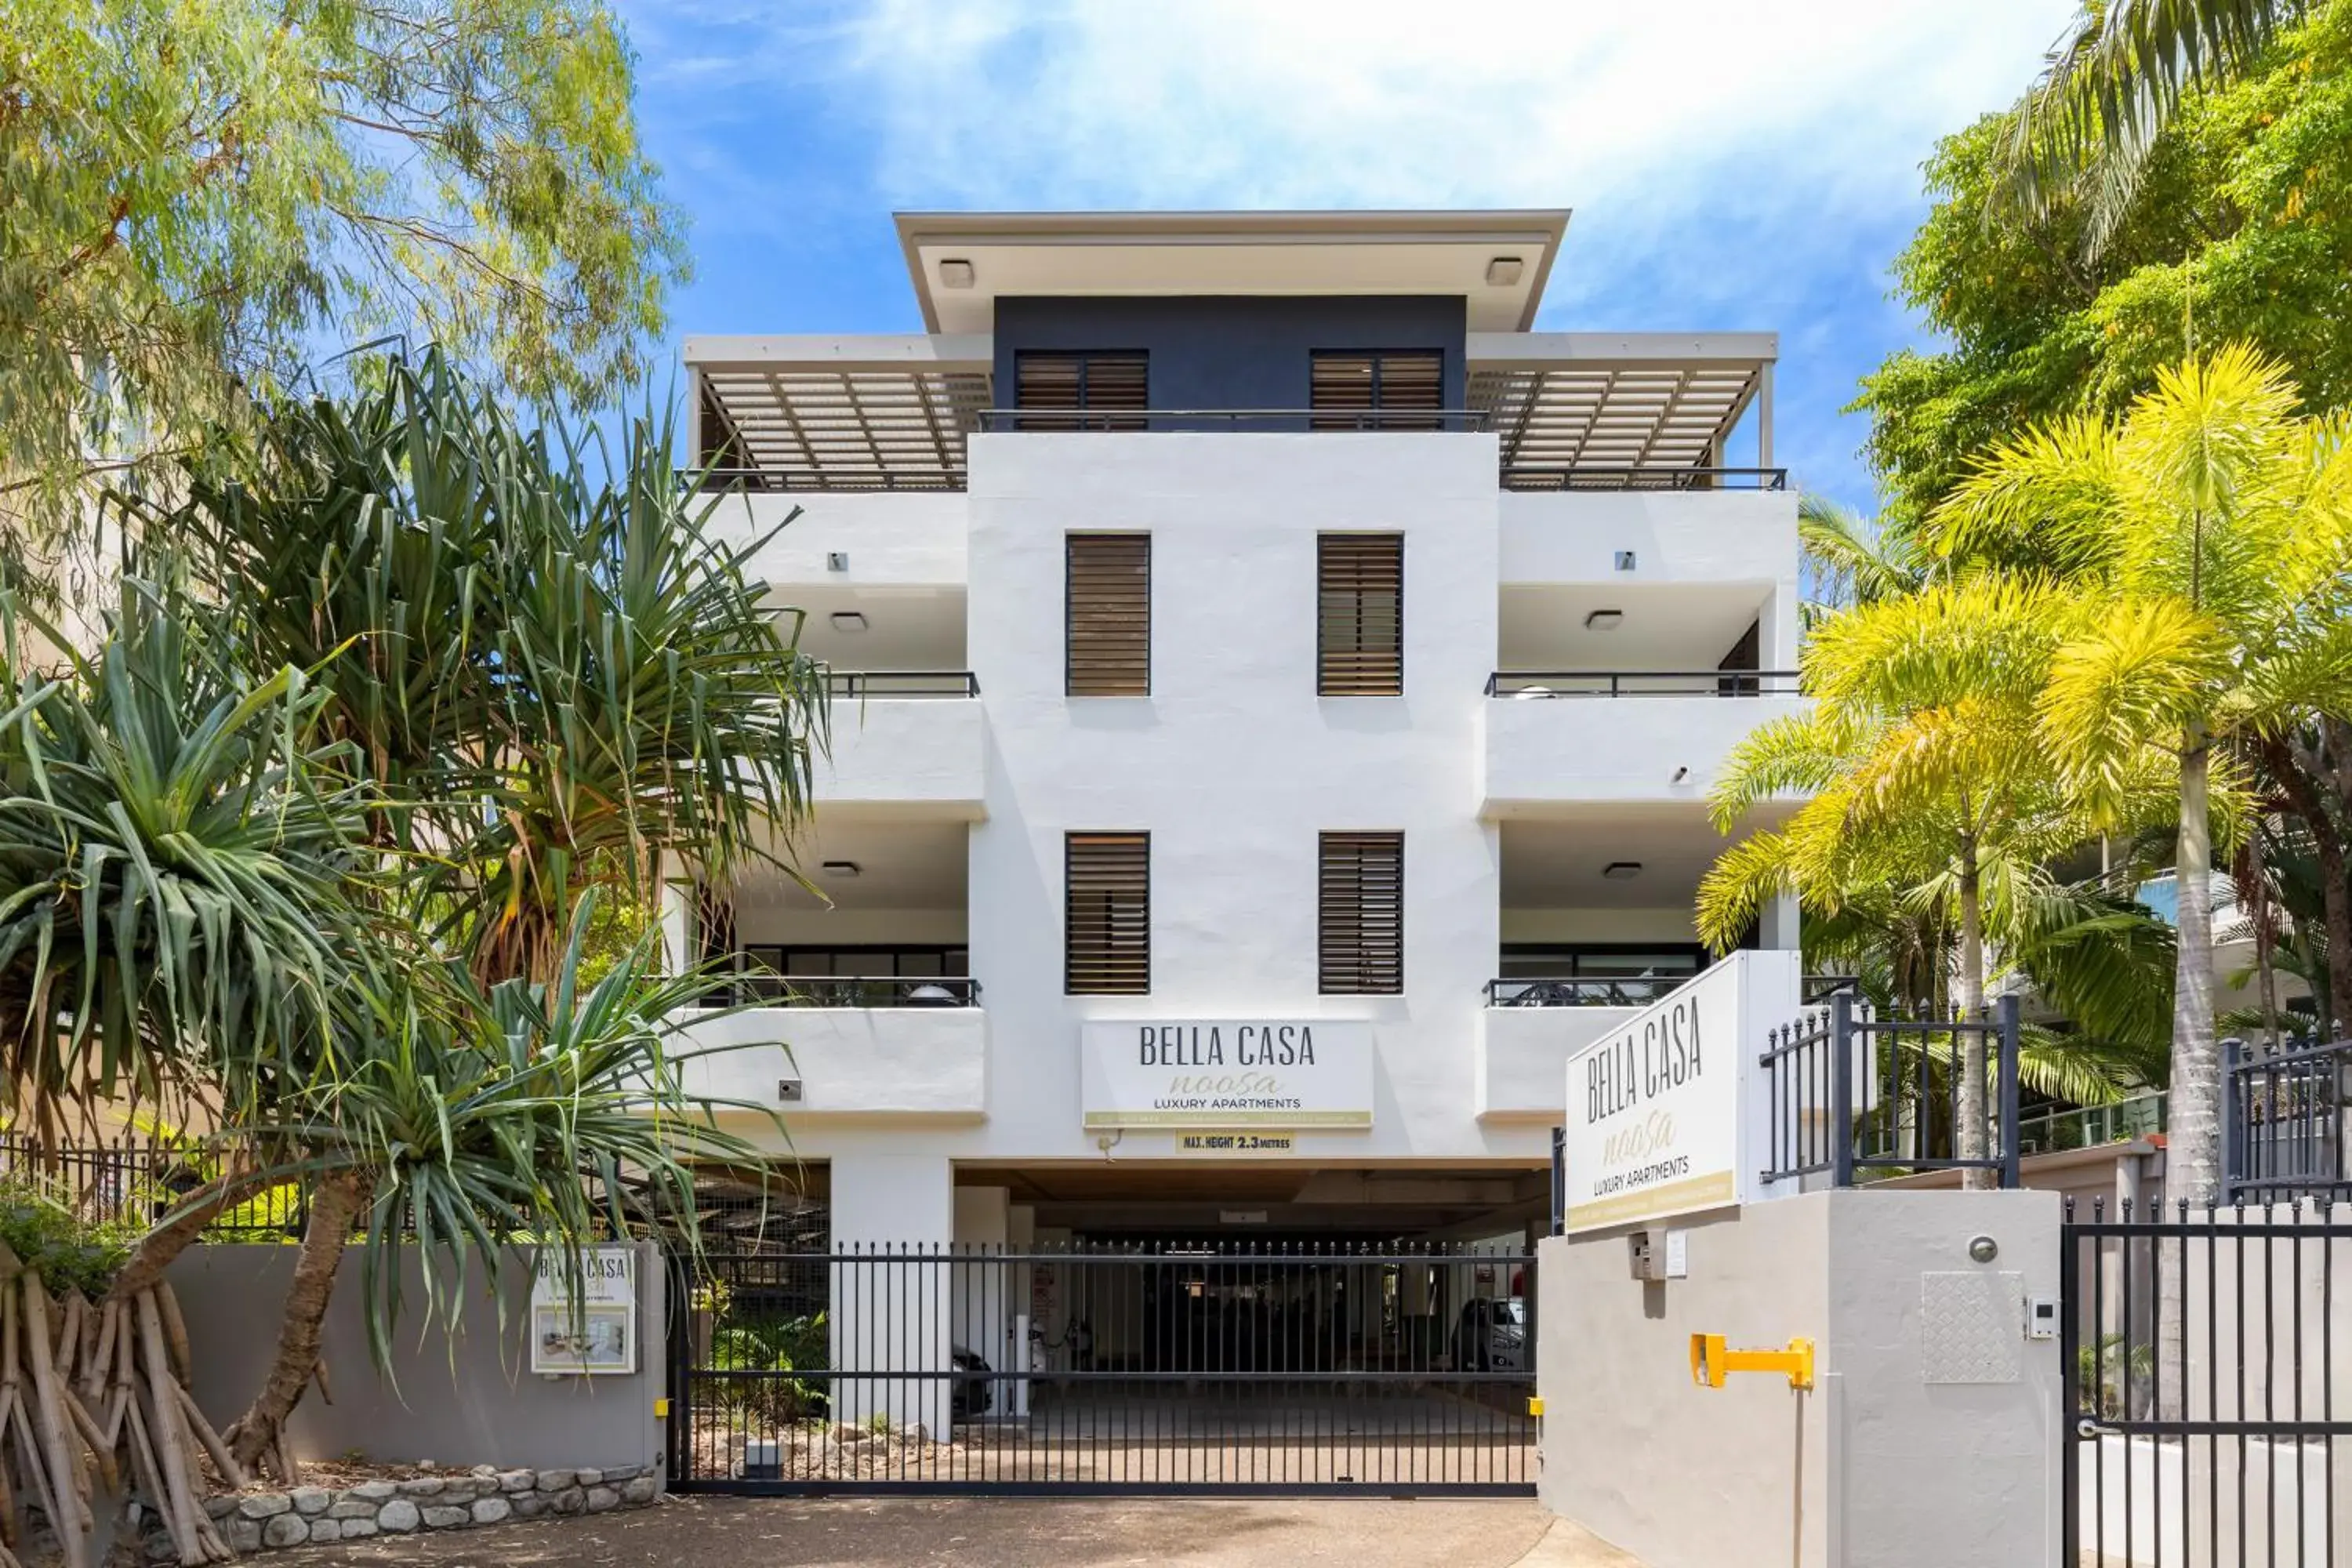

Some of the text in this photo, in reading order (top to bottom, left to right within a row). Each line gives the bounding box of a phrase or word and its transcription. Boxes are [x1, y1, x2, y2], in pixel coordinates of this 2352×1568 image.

[1139, 1025, 1316, 1066] BELLA CASA
[1587, 995, 1702, 1125] BELLA CASA
[1153, 1098, 1301, 1109] LUXURY APARTMENTS
[1169, 1071, 1283, 1095] noosa
[1260, 1139, 1290, 1149] METRES
[1602, 1109, 1676, 1168] noosa
[1594, 1155, 1690, 1197] LUXURY APARTMENTS
